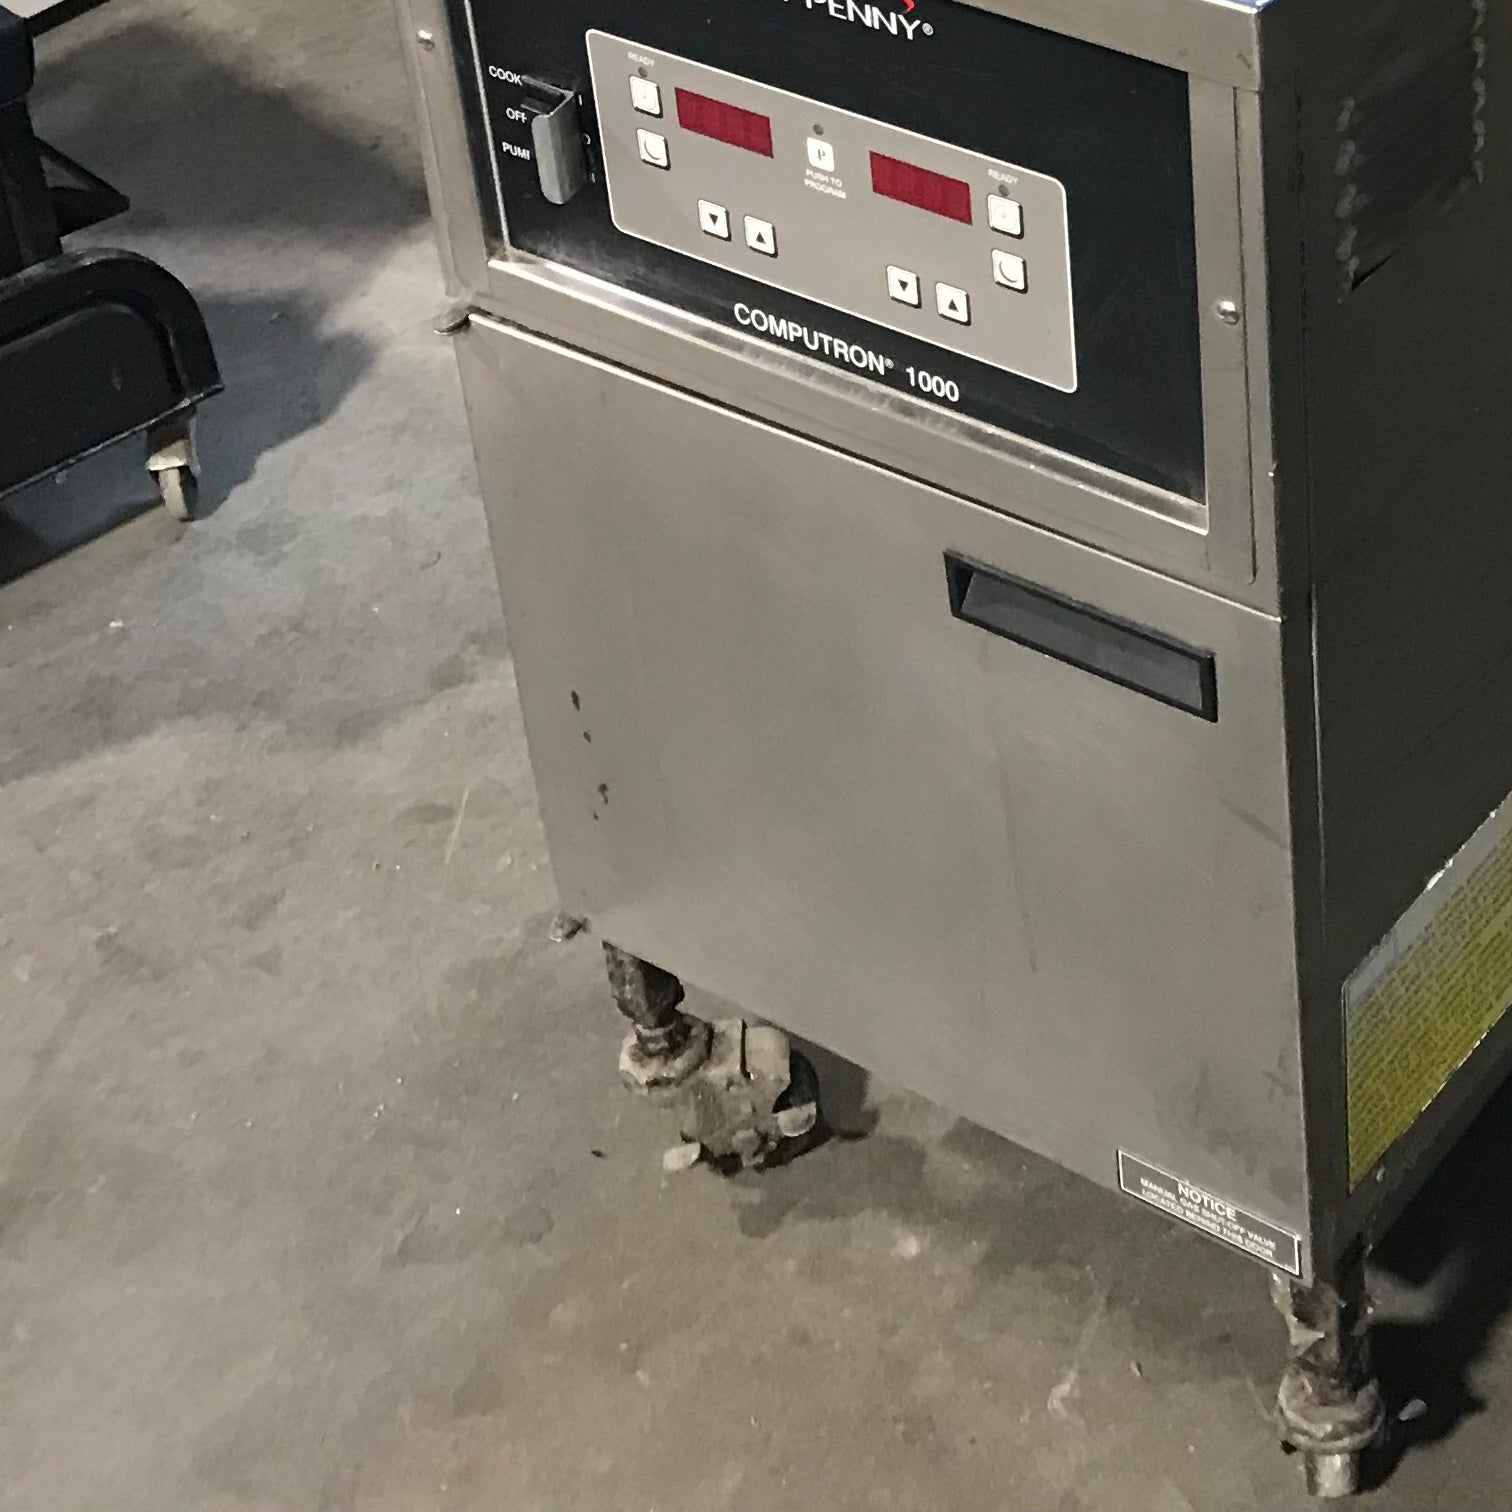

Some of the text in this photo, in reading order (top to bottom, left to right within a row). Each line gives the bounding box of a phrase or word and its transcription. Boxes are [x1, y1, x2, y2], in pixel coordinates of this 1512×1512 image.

[488, 65, 523, 86] COOK
[906, 366, 960, 403] 1000
[1177, 1181, 1237, 1222] NOTICE
